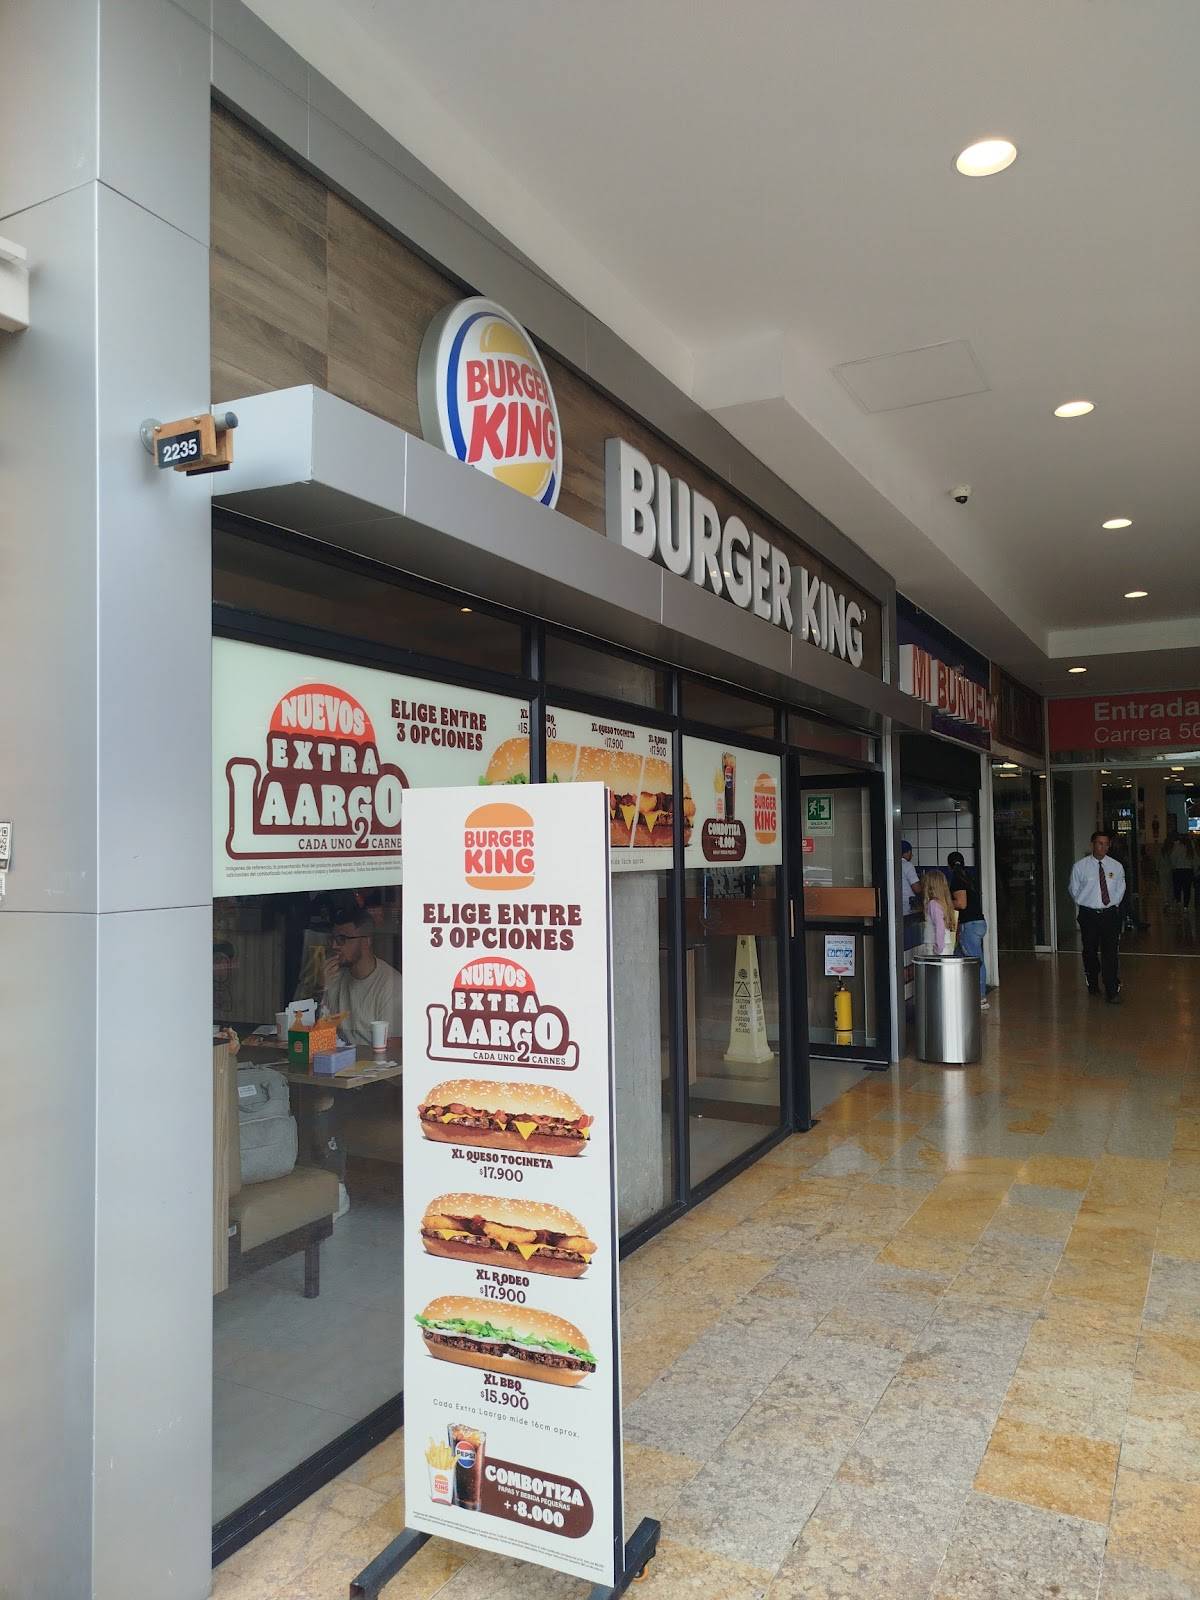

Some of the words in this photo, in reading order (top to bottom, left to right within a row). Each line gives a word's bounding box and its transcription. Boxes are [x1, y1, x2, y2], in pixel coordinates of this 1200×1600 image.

[467, 359, 550, 405] BURGER
[467, 401, 556, 463] KING
[163, 438, 197, 462] 2235
[606, 437, 793, 632] BURGER
[281, 693, 366, 736] NUEVOS
[391, 698, 437, 724] ELIGE
[440, 707, 487, 732] ENTRE
[520, 708, 529, 719] XL
[1094, 697, 1200, 721] Entrada
[396, 722, 407, 742] 3
[410, 724, 484, 751] OPCIONES
[1094, 726, 1171, 744] Carrera
[271, 737, 379, 775] EXTRA
[229, 762, 402, 854] LAARGO
[754, 794, 776, 810] BURGER
[298, 838, 328, 850] CADA
[330, 838, 352, 849] UNO
[354, 816, 371, 849] 2
[372, 837, 402, 849] CARNE
[754, 810, 776, 832] KING
[464, 829, 535, 849] BURGER
[464, 849, 535, 874] KING
[423, 903, 492, 925] ELIGE
[497, 903, 583, 926] ENTRE
[430, 927, 443, 948] 3
[449, 927, 575, 951] OPCIONES
[460, 962, 527, 988] NUEVOS
[454, 991, 538, 1014] EXTRA
[427, 1006, 570, 1064] LAARGO
[473, 1051, 496, 1062] CADA
[498, 1053, 516, 1063] UNO
[517, 1041, 530, 1062] 2
[532, 1055, 566, 1066] CARNES
[451, 1149, 465, 1160] XL
[466, 1151, 499, 1164] QUESO
[501, 1154, 554, 1170] TOCINETA
[479, 1166, 524, 1183] $17.900
[476, 1269, 491, 1281] XL
[492, 1270, 530, 1287] RODEO
[480, 1285, 526, 1304] $17.900
[483, 1373, 499, 1387] XL
[500, 1375, 526, 1395] BBQ
[480, 1388, 530, 1411] $15.900
[433, 1398, 453, 1409] Cada
[455, 1403, 476, 1414] Extra
[480, 1408, 507, 1421] Laargo
[509, 1415, 529, 1426] mide
[531, 1420, 551, 1431] 16cm
[456, 1449, 476, 1460] PEPSI
[434, 1482, 449, 1491] KING
[484, 1465, 585, 1506] COMBOTIZA
[497, 1485, 515, 1496] PAPAS
[520, 1491, 541, 1504] BEBIDA
[541, 1496, 571, 1511] PEQUEÑAS
